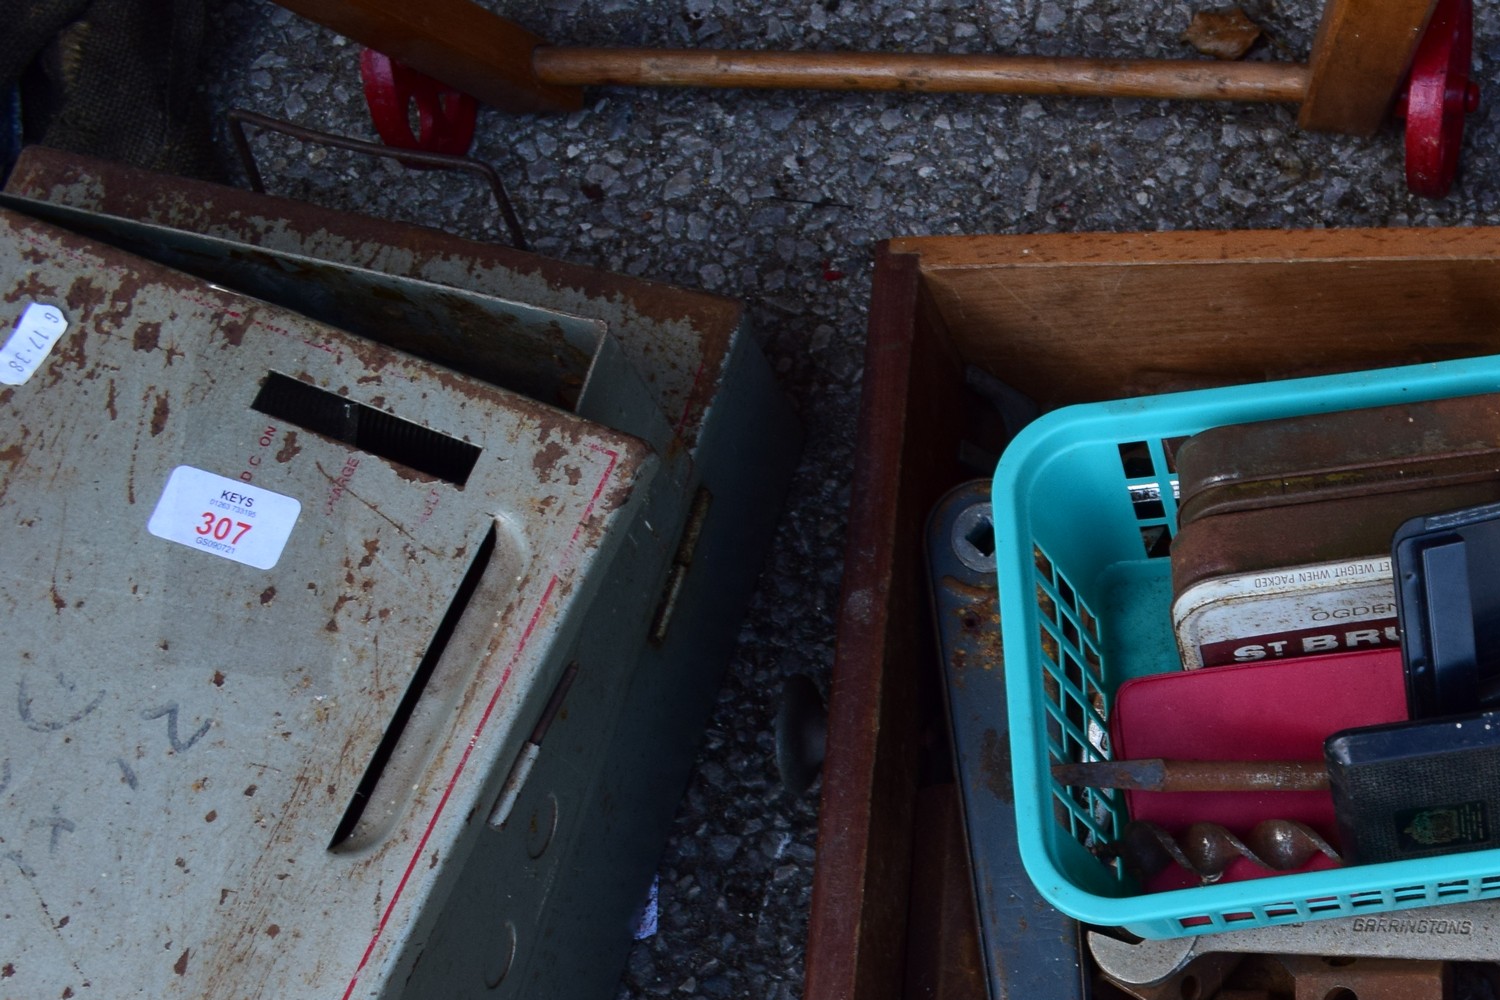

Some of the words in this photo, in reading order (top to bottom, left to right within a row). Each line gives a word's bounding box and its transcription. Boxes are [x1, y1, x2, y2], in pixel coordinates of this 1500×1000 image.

[259, 426, 277, 447] ON
[221, 490, 254, 507] KEYS
[196, 512, 252, 545] 307
[196, 537, 236, 554] GS090721
[1334, 564, 1375, 577] WEIGHT
[1378, 561, 1392, 572] ET
[1254, 576, 1295, 588] PACKED
[1299, 571, 1331, 583] WHEN
[1352, 917, 1473, 935] GARRINGTONS
